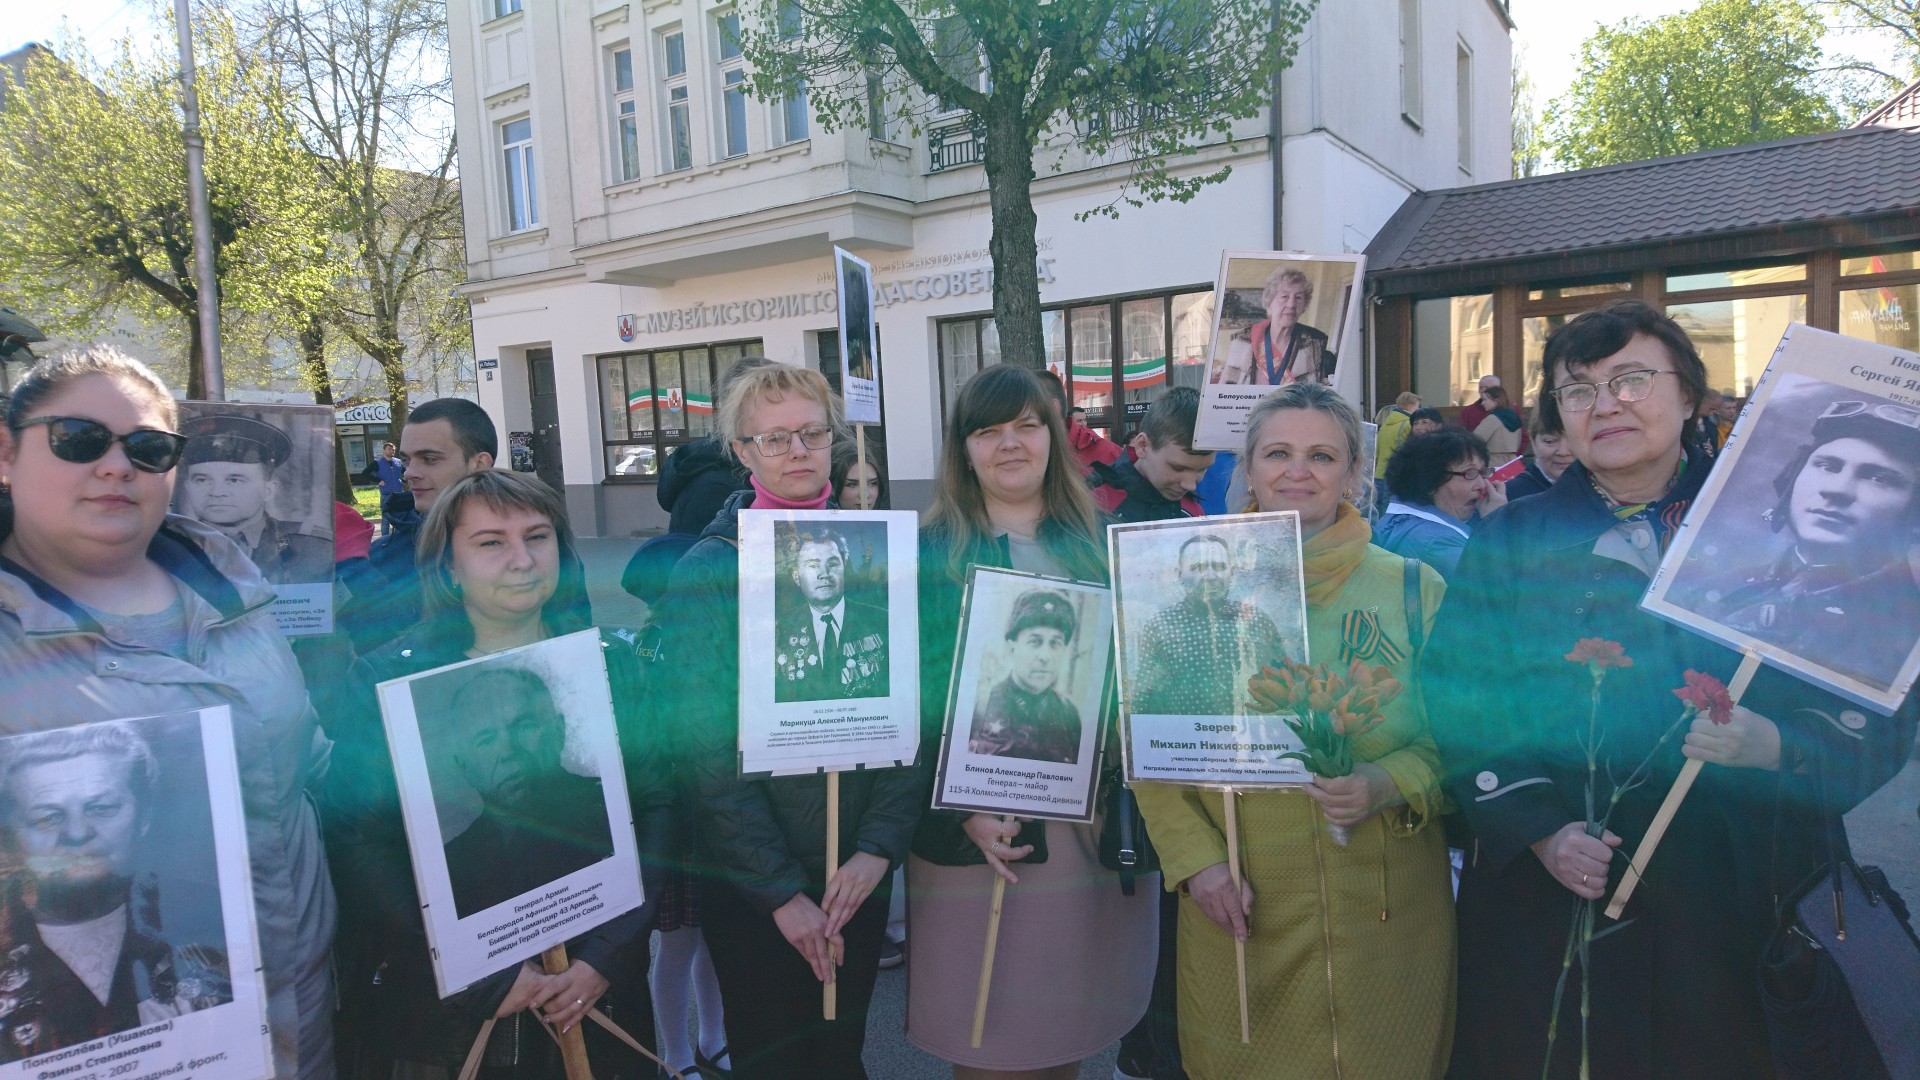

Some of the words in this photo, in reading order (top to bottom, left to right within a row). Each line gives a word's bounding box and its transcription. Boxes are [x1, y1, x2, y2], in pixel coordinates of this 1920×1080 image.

[914, 252, 970, 271] HISTORY
[645, 302, 705, 333] МУЗЕЙ
[712, 293, 806, 328] ИСТОРИИ
[813, 280, 906, 315] ГОДА
[912, 257, 1056, 302] СОВЕТА
[1891, 356, 1920, 372] Пов
[1850, 365, 1901, 386] Сергей
[1218, 393, 1257, 401] Белоусова
[780, 719, 816, 728] Марикуца
[817, 716, 846, 725] Алексей
[846, 714, 889, 723] Мануилович
[1193, 722, 1238, 734] Зверев
[1149, 739, 1197, 750] Михаил
[1199, 740, 1290, 753] Никифорович
[965, 764, 994, 774] Блинов
[995, 767, 1036, 780] Александр
[1036, 771, 1073, 782] Павлович
[987, 777, 1016, 788] Генерал
[1024, 781, 1048, 791] майор
[949, 785, 970, 794] 115-й
[971, 787, 1008, 798] Холмской
[1008, 791, 1051, 803] стрелковой
[1051, 796, 1083, 806] дивизии
[513, 896, 544, 914] Генерал
[544, 885, 570, 901] Армии
[477, 916, 524, 940] Белобородов
[525, 902, 558, 920] Афанасий
[558, 881, 603, 905] Павлантьевич
[488, 927, 520, 947] Бывший
[521, 912, 558, 932] командир
[559, 906, 569, 916] 43
[569, 893, 599, 911] Армией,
[487, 940, 518, 959] дважды
[518, 930, 540, 945] Герой
[541, 912, 581, 934] Советского
[582, 901, 604, 916] Союза
[22, 1041, 104, 1071] Понтоплёва
[107, 1019, 174, 1049] (Ушакова)
[84, 1040, 162, 1069] Степановна
[108, 1060, 139, 1078] 2007
[187, 1051, 228, 1071] фронт,
